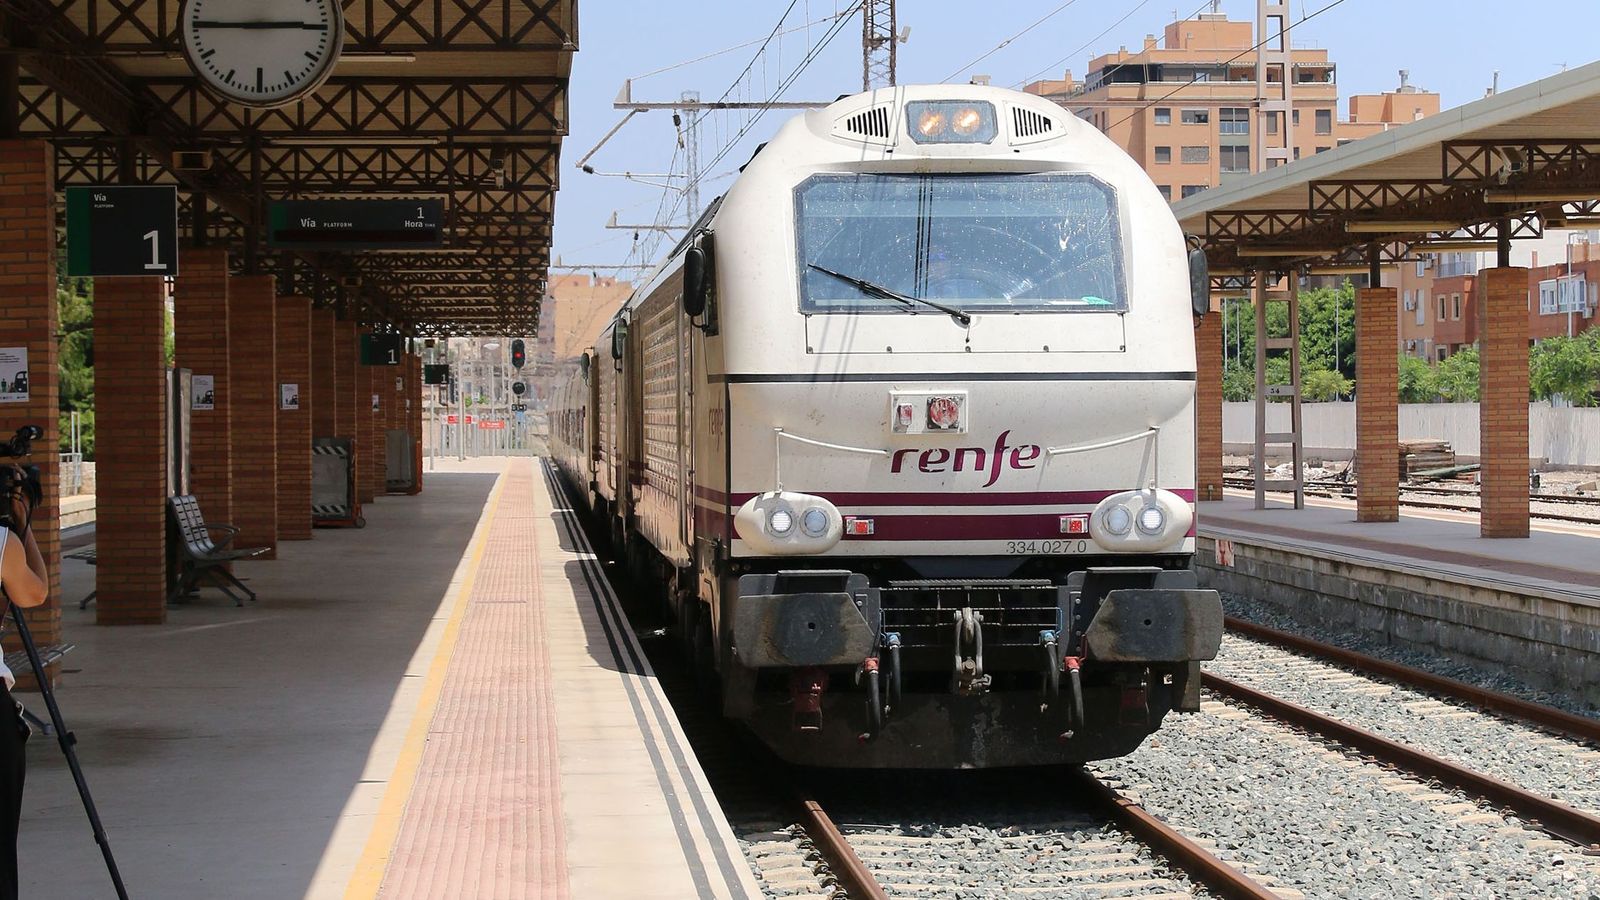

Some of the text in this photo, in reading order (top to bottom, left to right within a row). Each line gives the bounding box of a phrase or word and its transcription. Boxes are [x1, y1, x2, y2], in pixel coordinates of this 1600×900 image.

[417, 207, 425, 219] 1
[300, 217, 317, 228] Vía
[404, 220, 423, 228] Hora
[143, 230, 167, 270] 1
[387, 348, 398, 364] 1
[441, 374, 448, 384] 1
[891, 430, 1041, 489] renfe
[1006, 540, 1087, 554] 334.027.0
